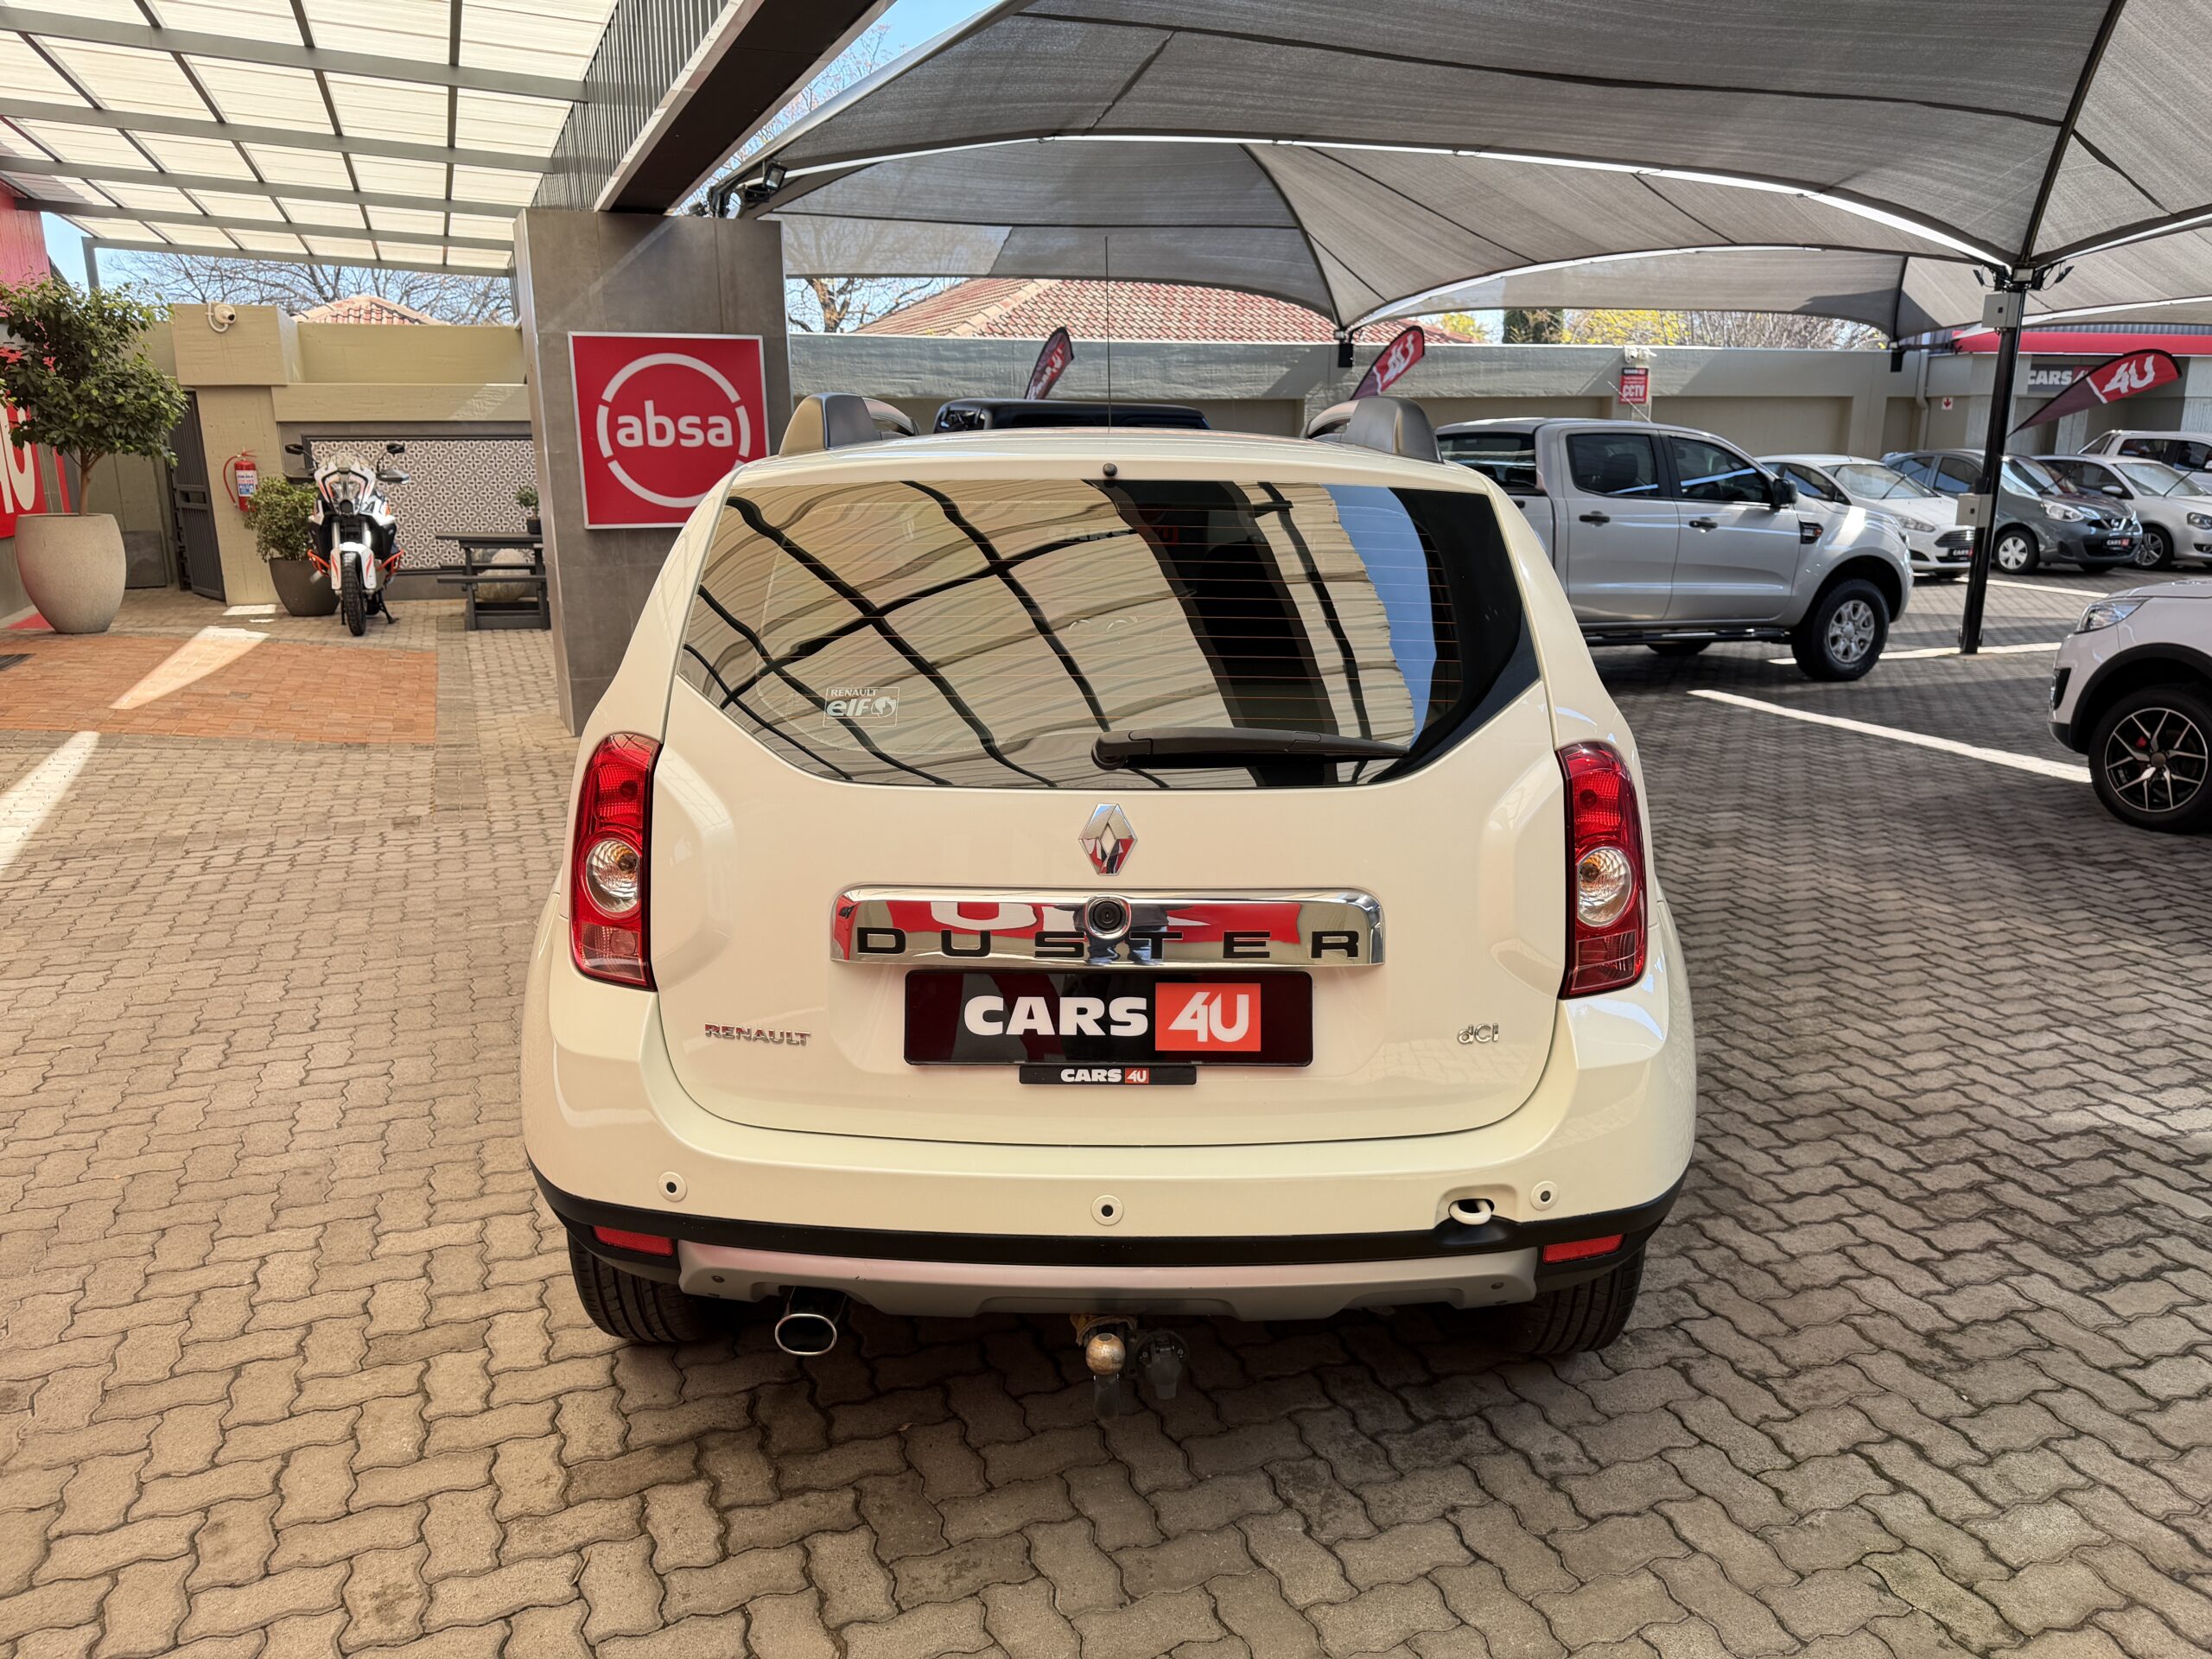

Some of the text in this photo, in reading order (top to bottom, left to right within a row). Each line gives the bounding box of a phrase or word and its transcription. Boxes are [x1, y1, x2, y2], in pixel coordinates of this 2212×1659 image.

[2101, 354, 2156, 394] 4U
[1623, 384, 1646, 397] CCTV
[616, 399, 734, 448] absa
[830, 689, 879, 697] RENAULT
[826, 698, 872, 717] elf
[856, 926, 1360, 960] DUSTER
[963, 991, 1250, 1043] CARS 4U
[704, 1022, 811, 1046] RENAULT
[1060, 1068, 1147, 1084] CARS 4U
